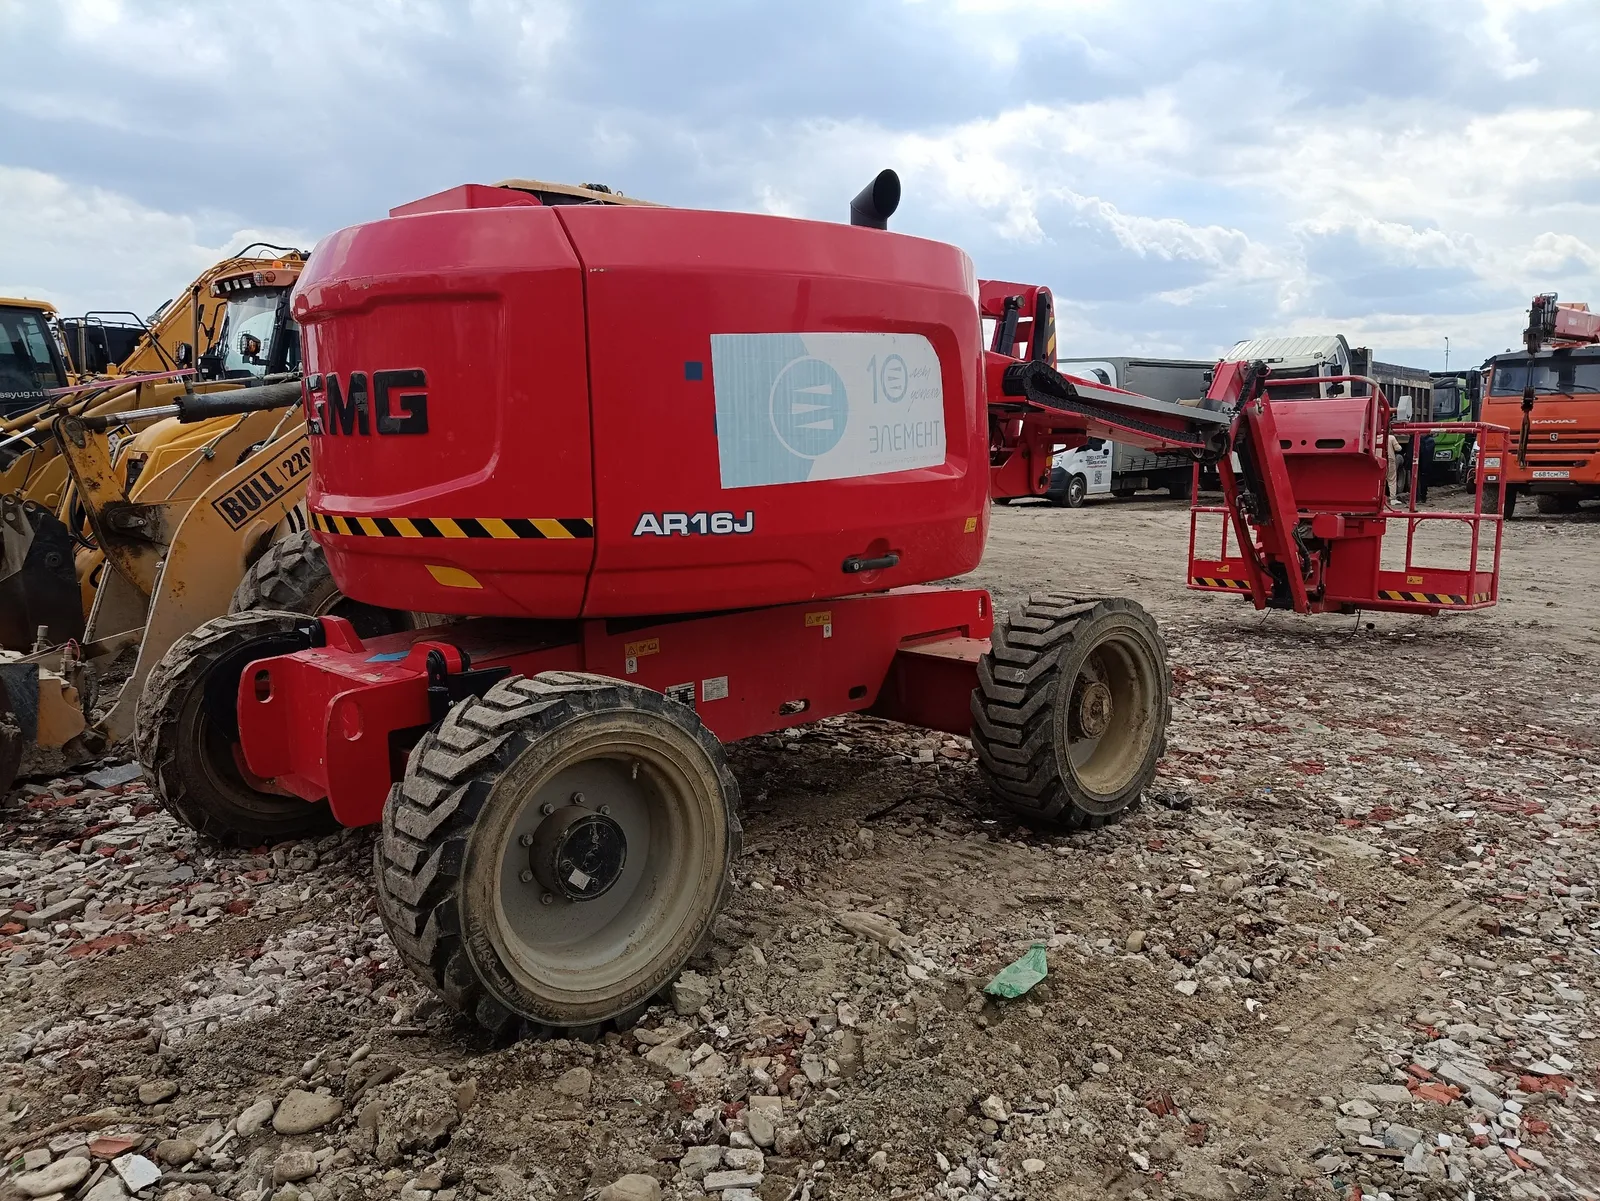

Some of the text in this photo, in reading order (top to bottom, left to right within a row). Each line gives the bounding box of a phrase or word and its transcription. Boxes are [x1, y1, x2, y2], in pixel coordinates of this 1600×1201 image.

[866, 353, 909, 404] 10
[868, 419, 940, 454] ЭЛЕМЕНТ
[219, 467, 284, 524] BULL
[633, 511, 755, 537] AR16J
